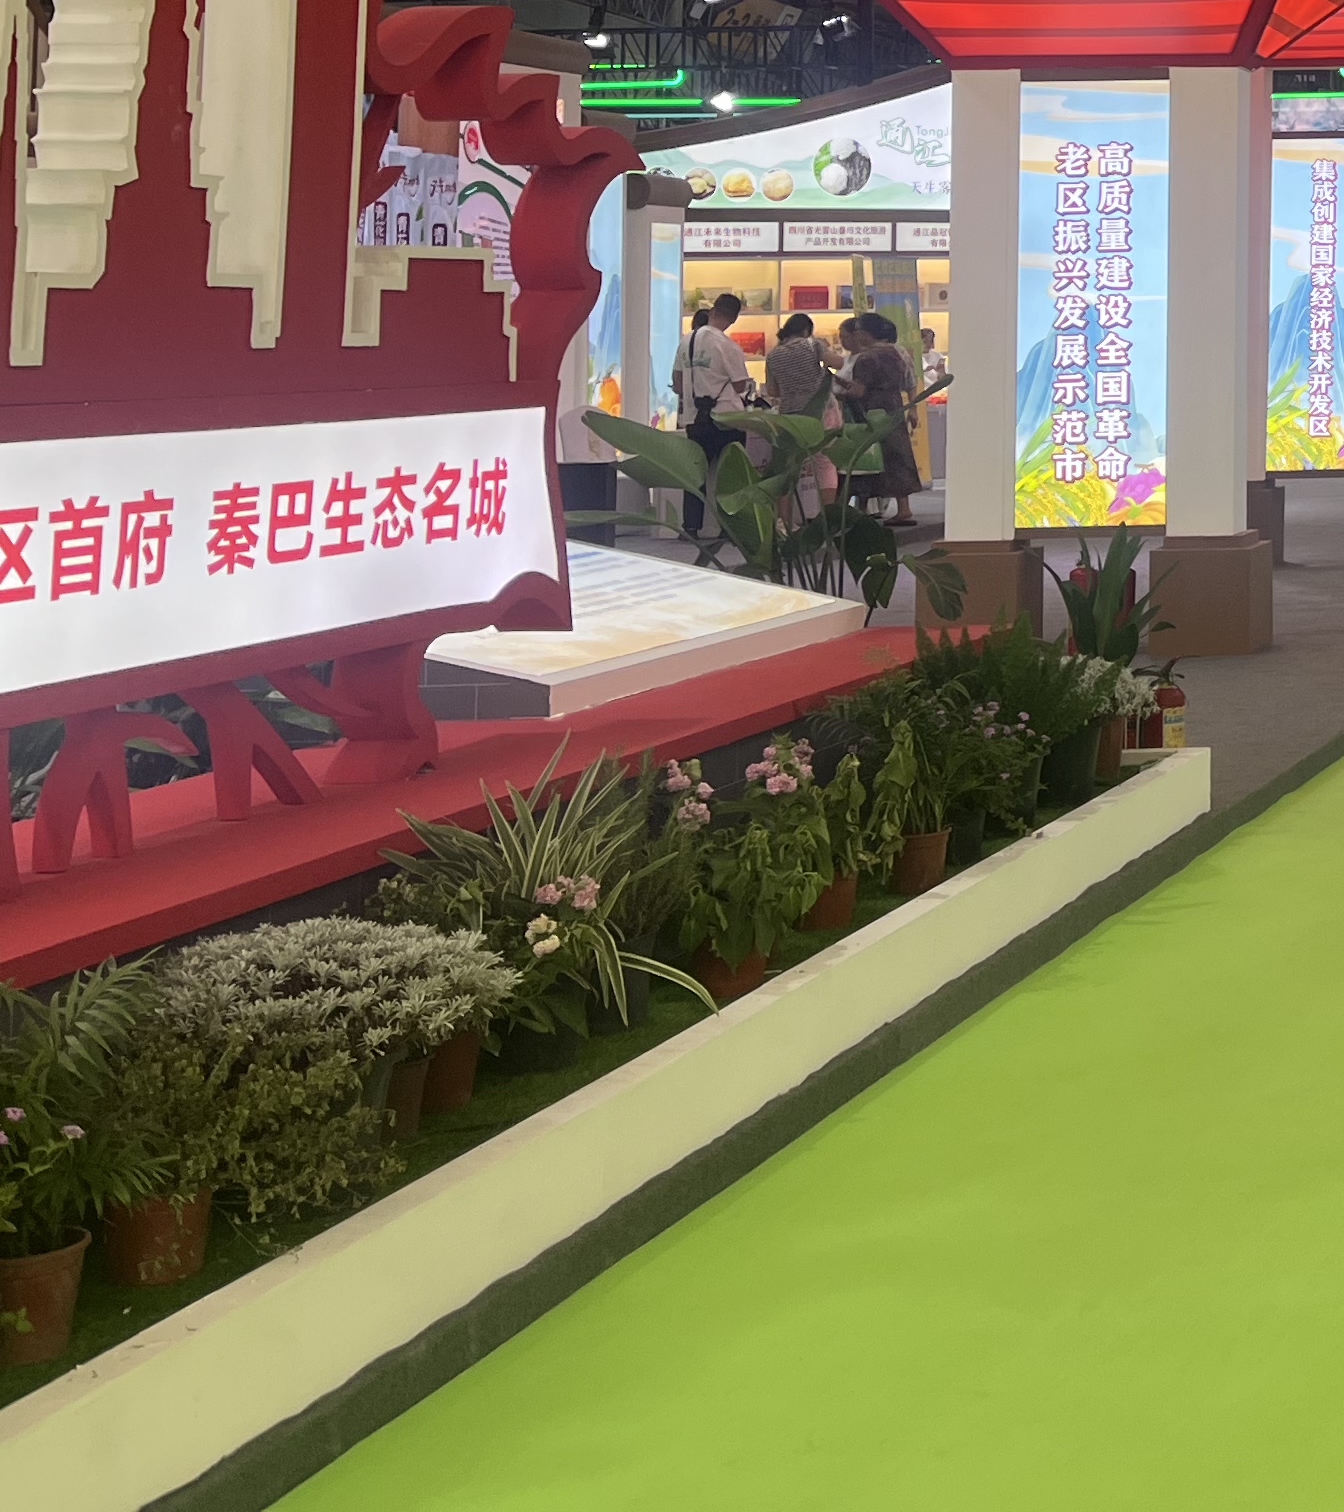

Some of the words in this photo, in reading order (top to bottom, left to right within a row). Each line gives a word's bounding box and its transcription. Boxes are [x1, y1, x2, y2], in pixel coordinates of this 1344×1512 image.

[1052, 142, 1091, 484] 老区振兴发展示范市
[1094, 141, 1134, 482] 高质量建设全国革命
[1307, 158, 1337, 439] 集成创建国家经济技术开发区
[206, 456, 509, 577] 秦巴生态名城
